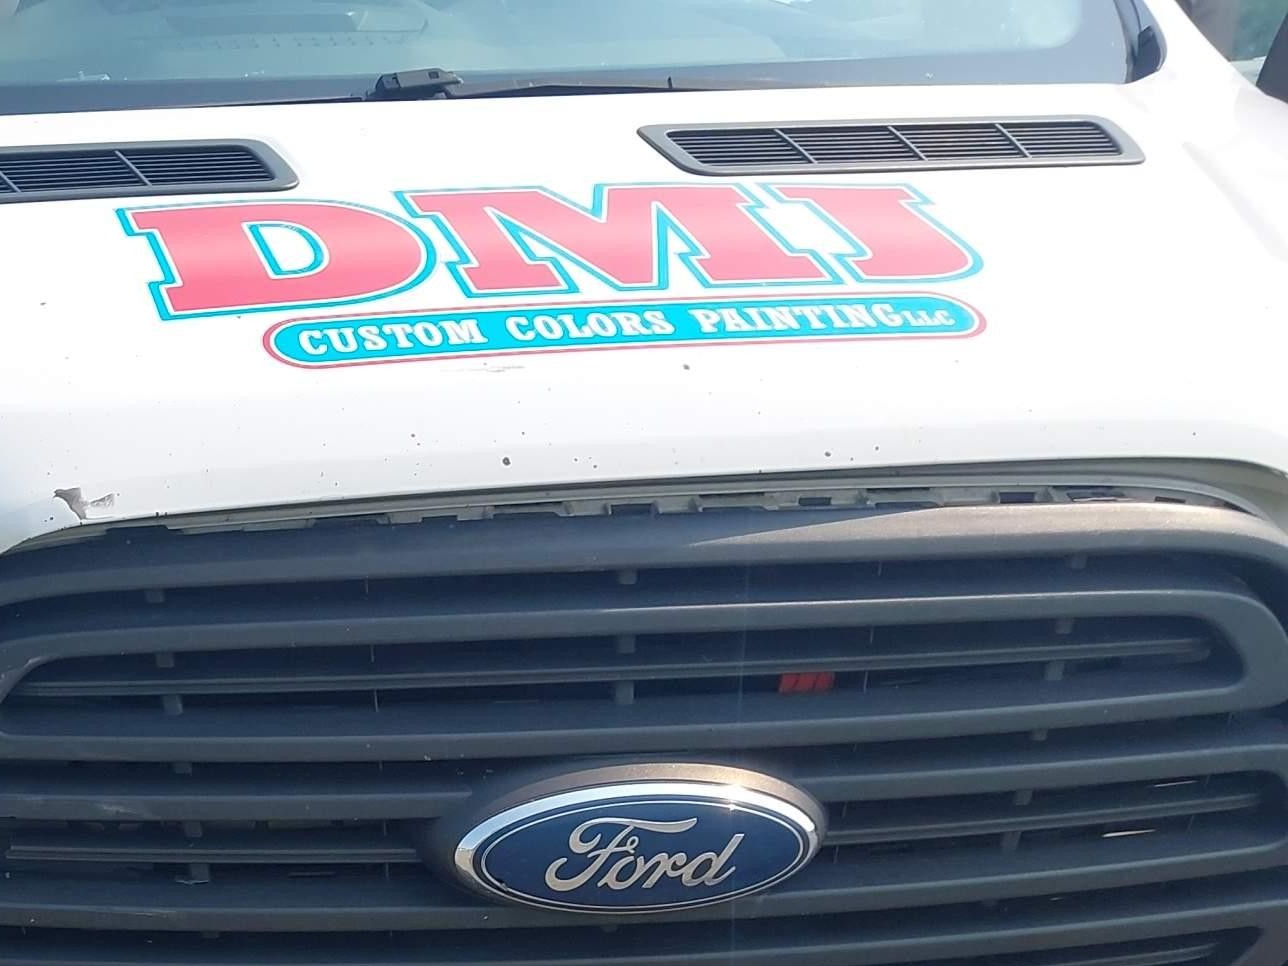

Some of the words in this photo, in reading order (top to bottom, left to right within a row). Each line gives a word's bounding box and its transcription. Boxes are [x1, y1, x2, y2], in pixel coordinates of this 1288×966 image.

[116, 182, 986, 321] DMJ
[298, 319, 488, 355] CUSTOM
[505, 310, 675, 341] COLORS
[544, 816, 745, 892] Ford
